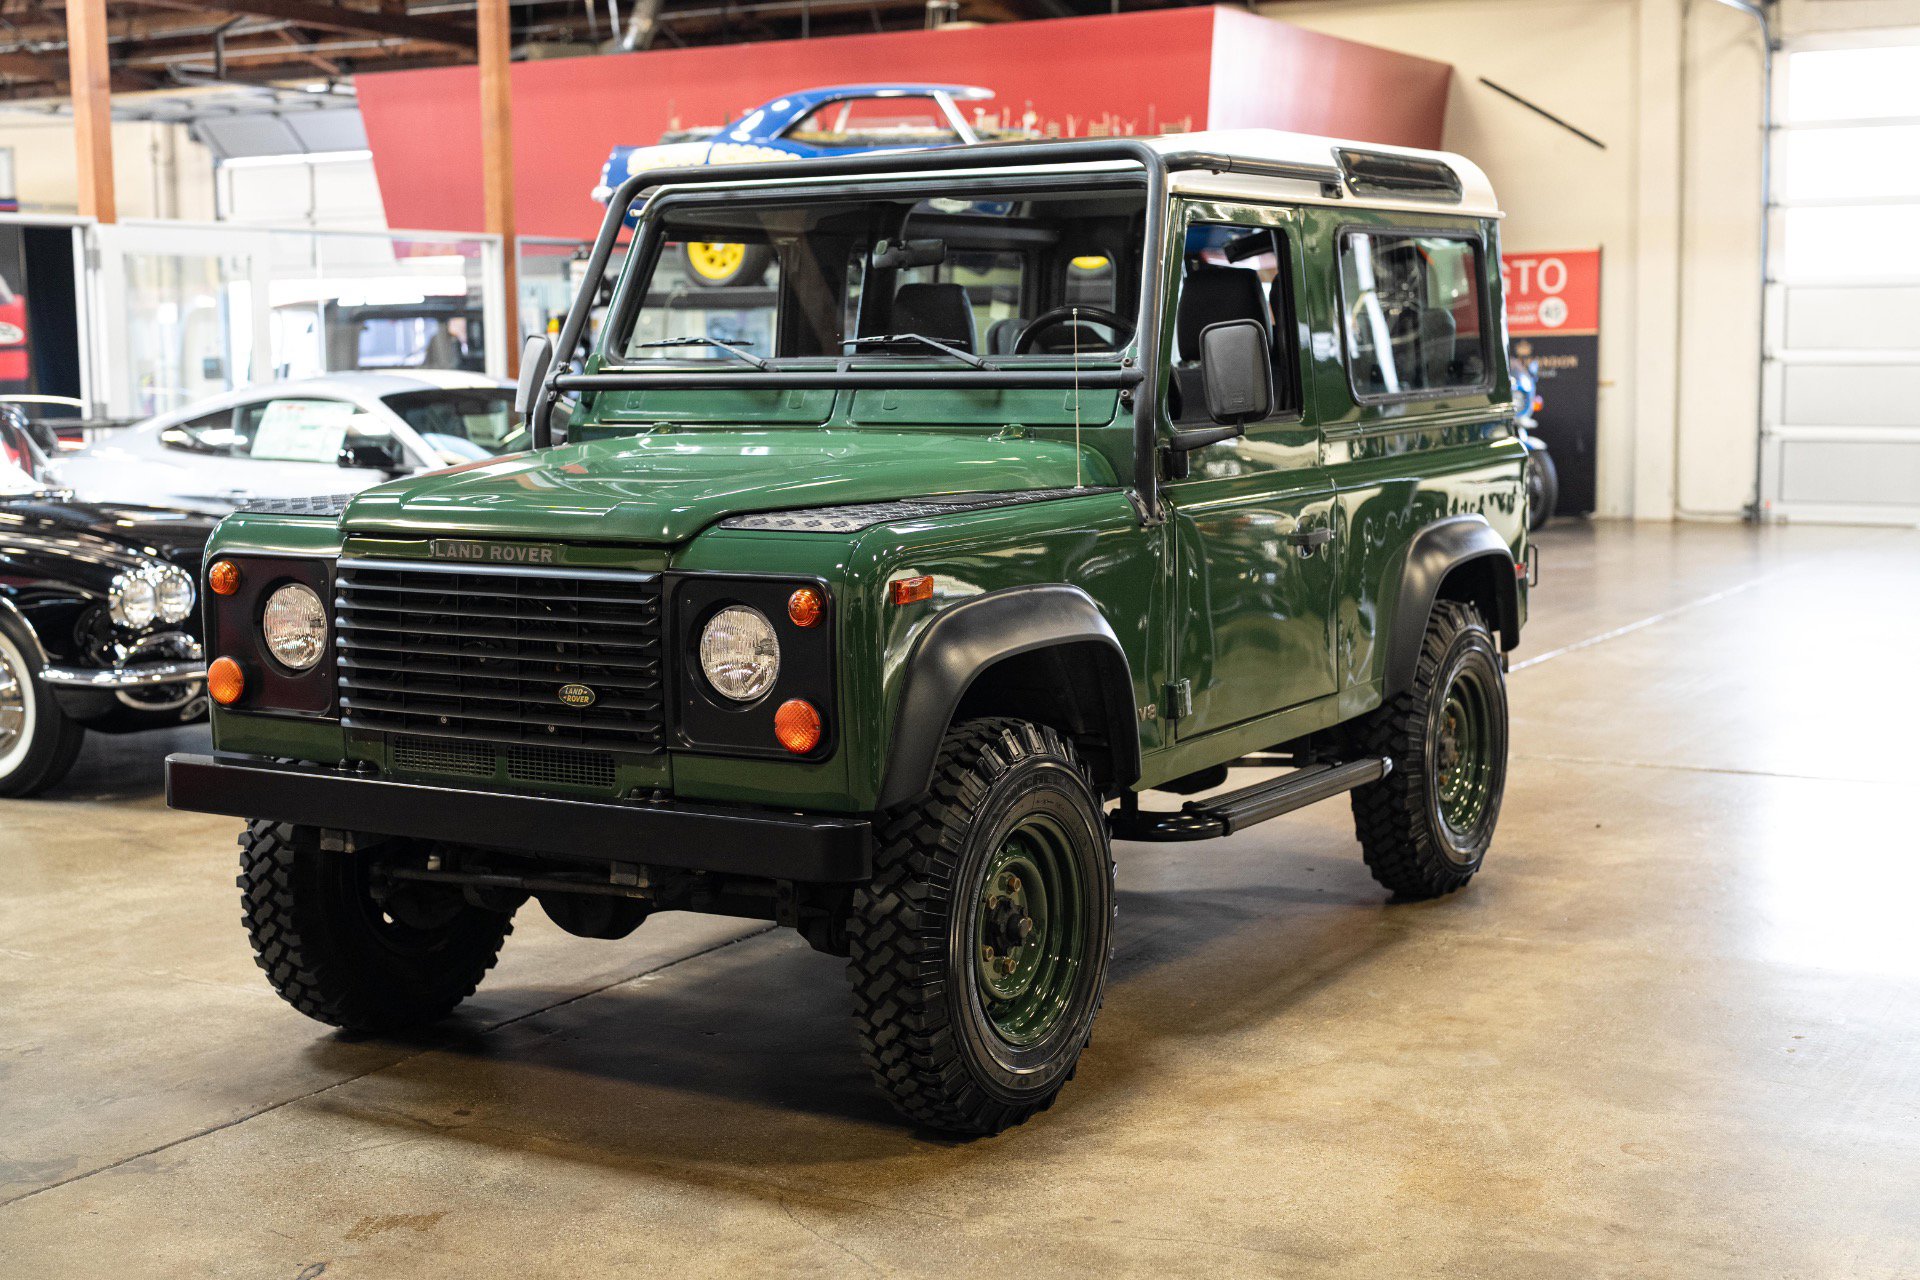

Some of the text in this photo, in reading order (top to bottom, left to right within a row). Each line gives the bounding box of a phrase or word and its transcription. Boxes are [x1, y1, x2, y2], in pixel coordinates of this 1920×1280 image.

[435, 542, 553, 563] LAND ROVER
[564, 686, 584, 696] LAND
[566, 695, 590, 703] ROVER
[1138, 703, 1157, 721] V8
